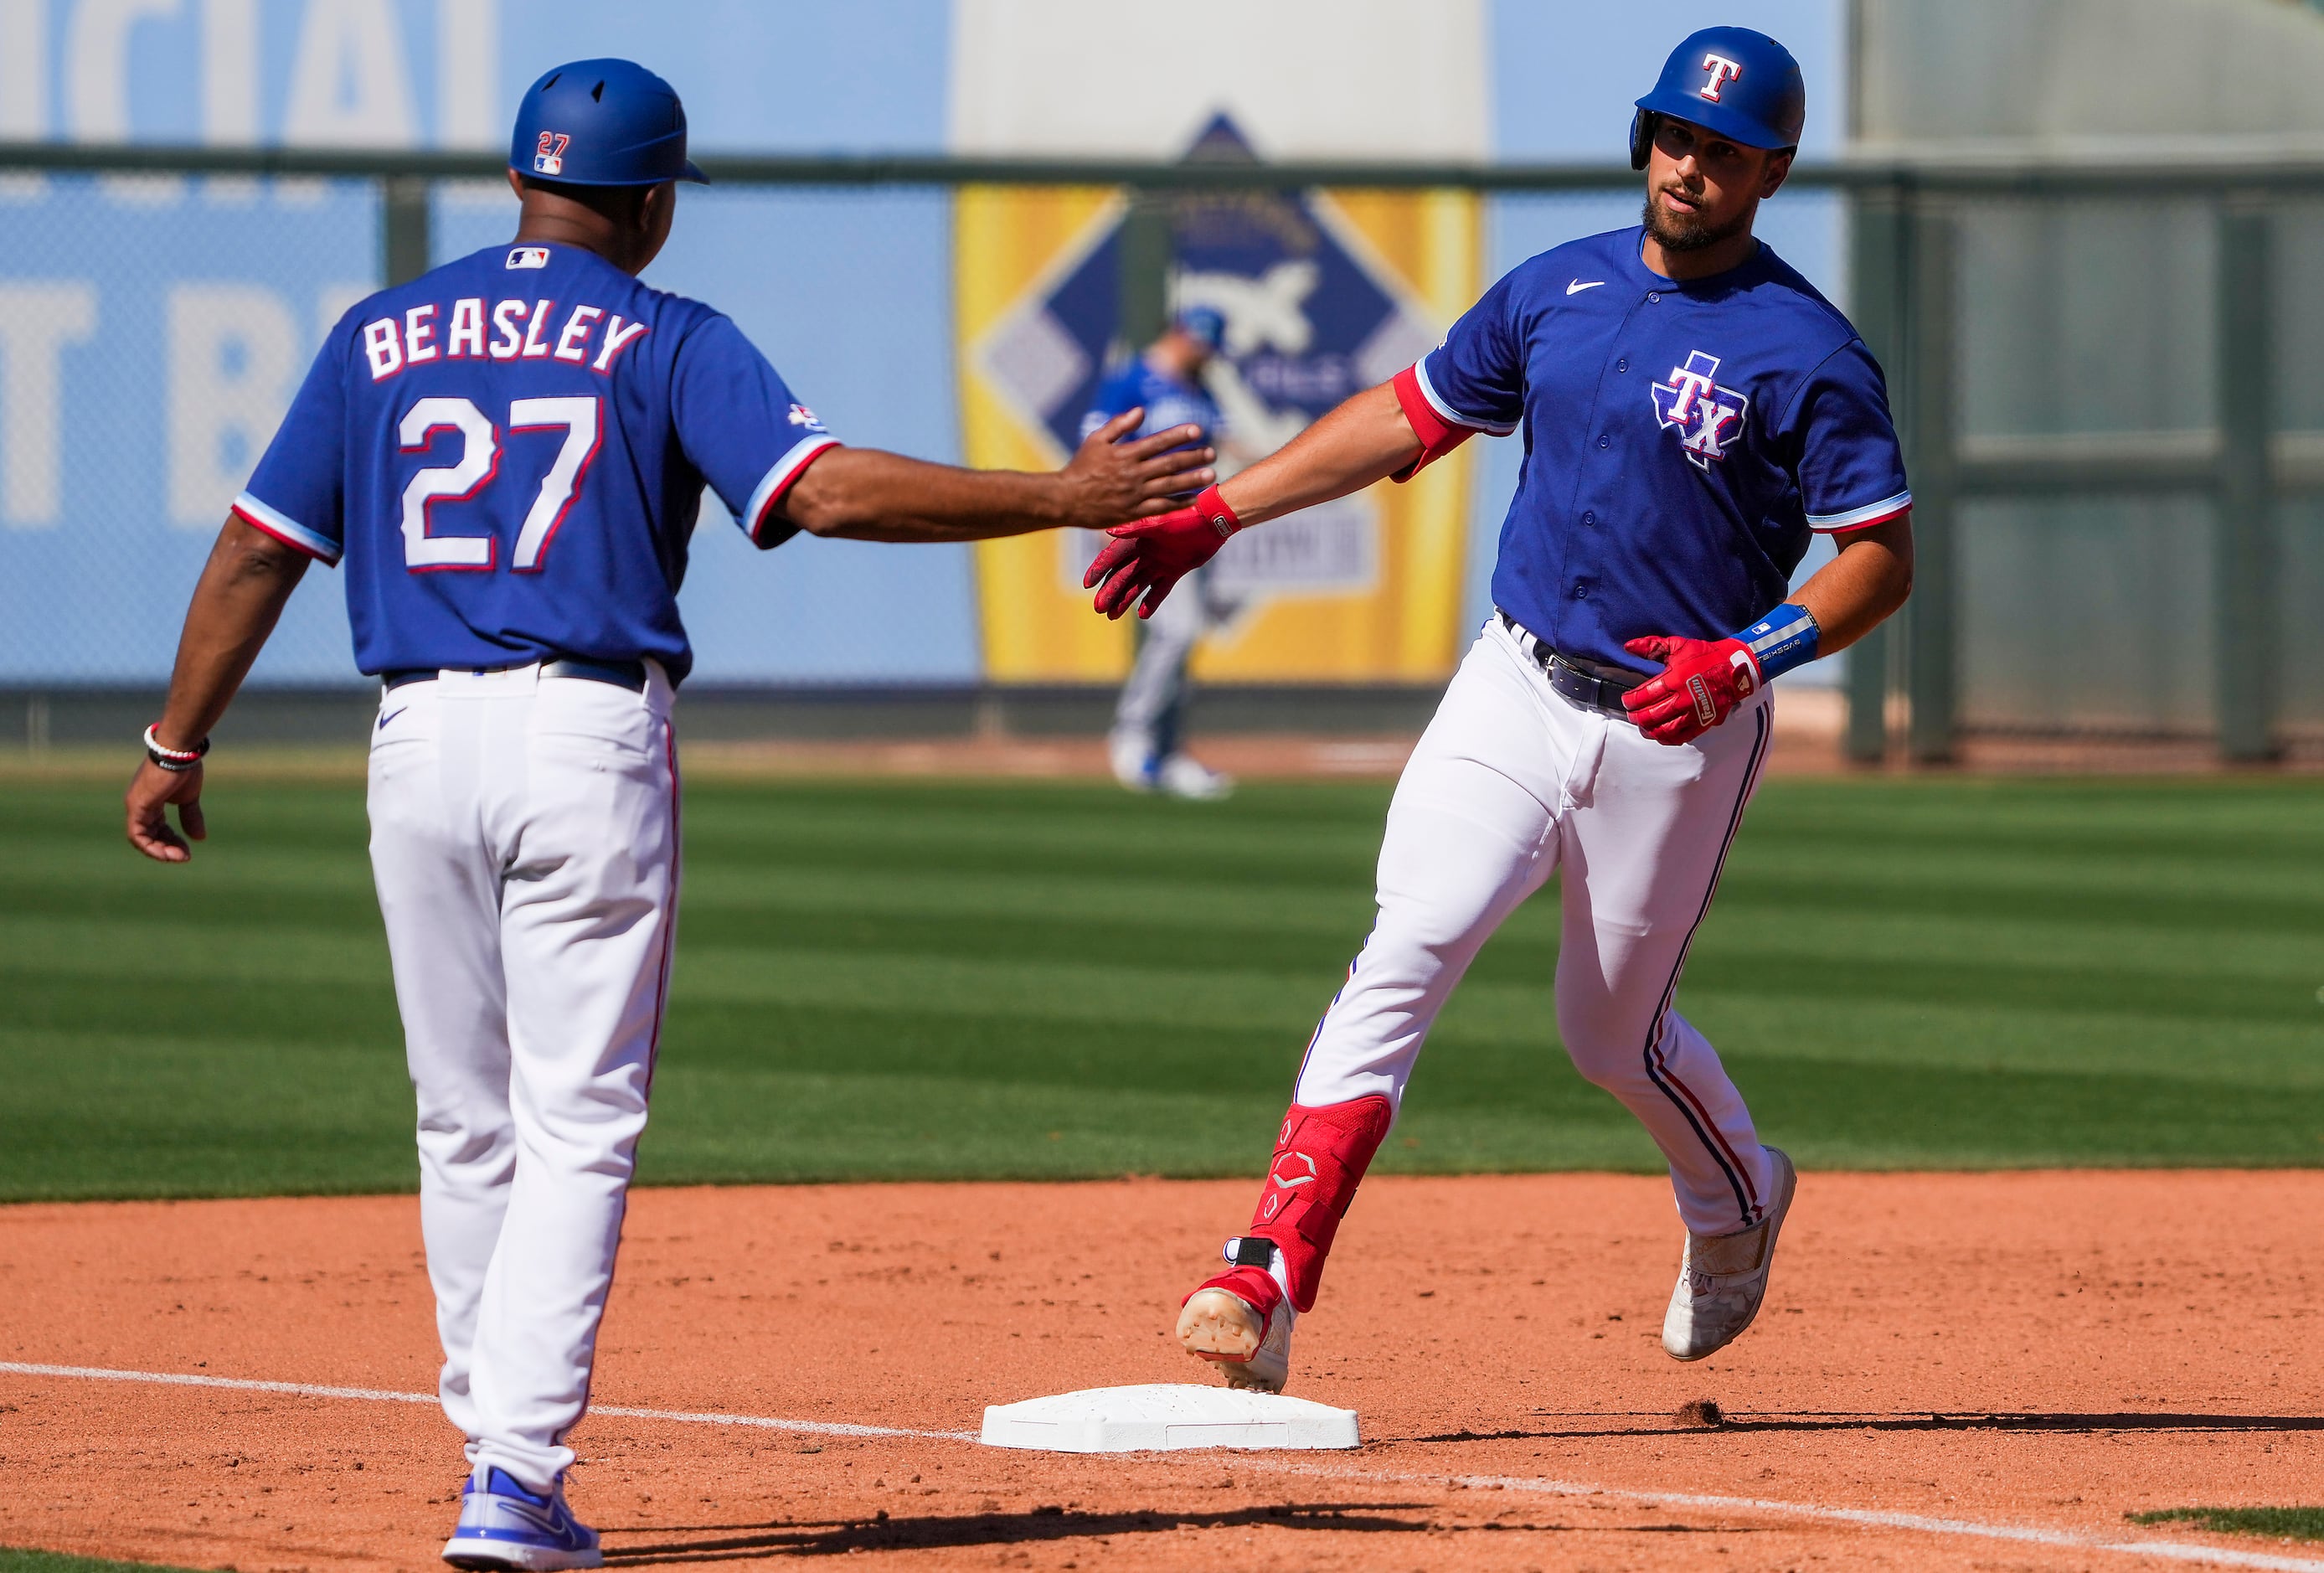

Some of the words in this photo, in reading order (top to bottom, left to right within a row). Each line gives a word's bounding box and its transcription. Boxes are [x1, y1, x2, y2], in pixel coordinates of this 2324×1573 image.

[1701, 53, 1742, 103] T
[538, 131, 570, 157] 27
[363, 298, 650, 382] BEASLEY
[399, 397, 605, 574] 27
